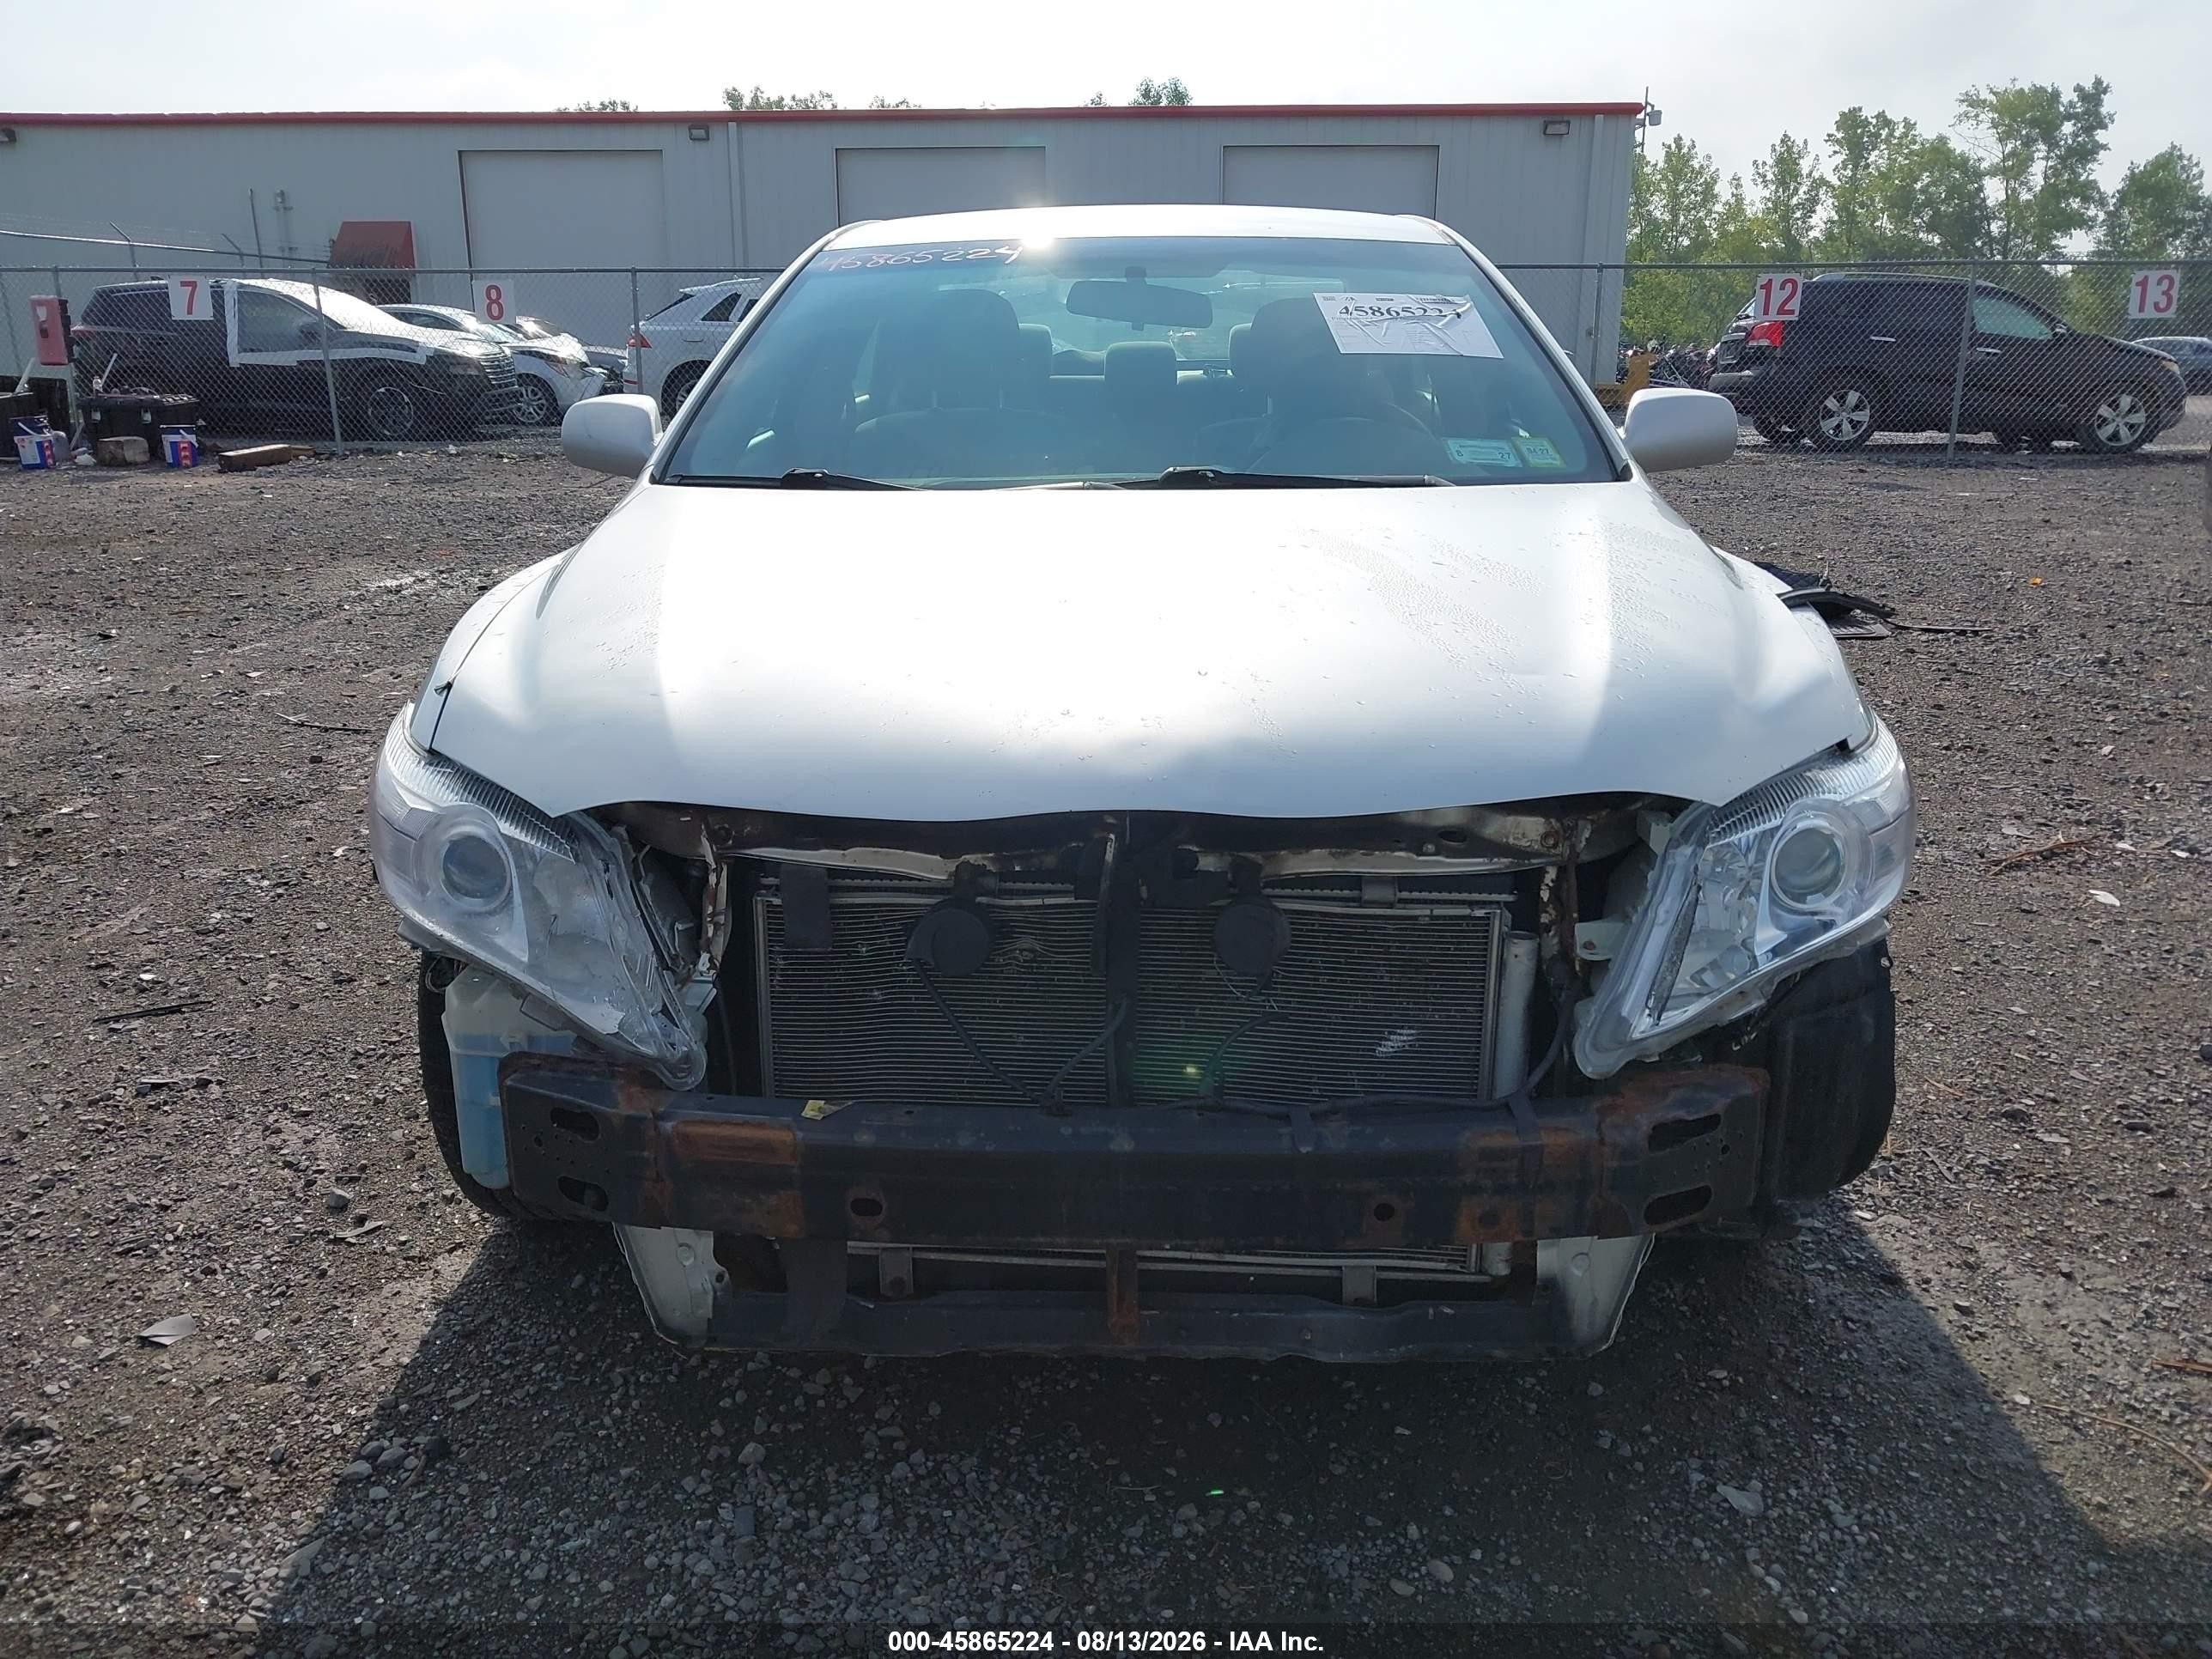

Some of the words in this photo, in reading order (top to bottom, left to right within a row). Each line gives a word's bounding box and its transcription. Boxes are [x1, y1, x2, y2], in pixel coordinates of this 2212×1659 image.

[179, 280, 198, 315] 7
[485, 284, 504, 321] 8
[1759, 277, 1800, 316] 12
[2135, 274, 2176, 313] 13
